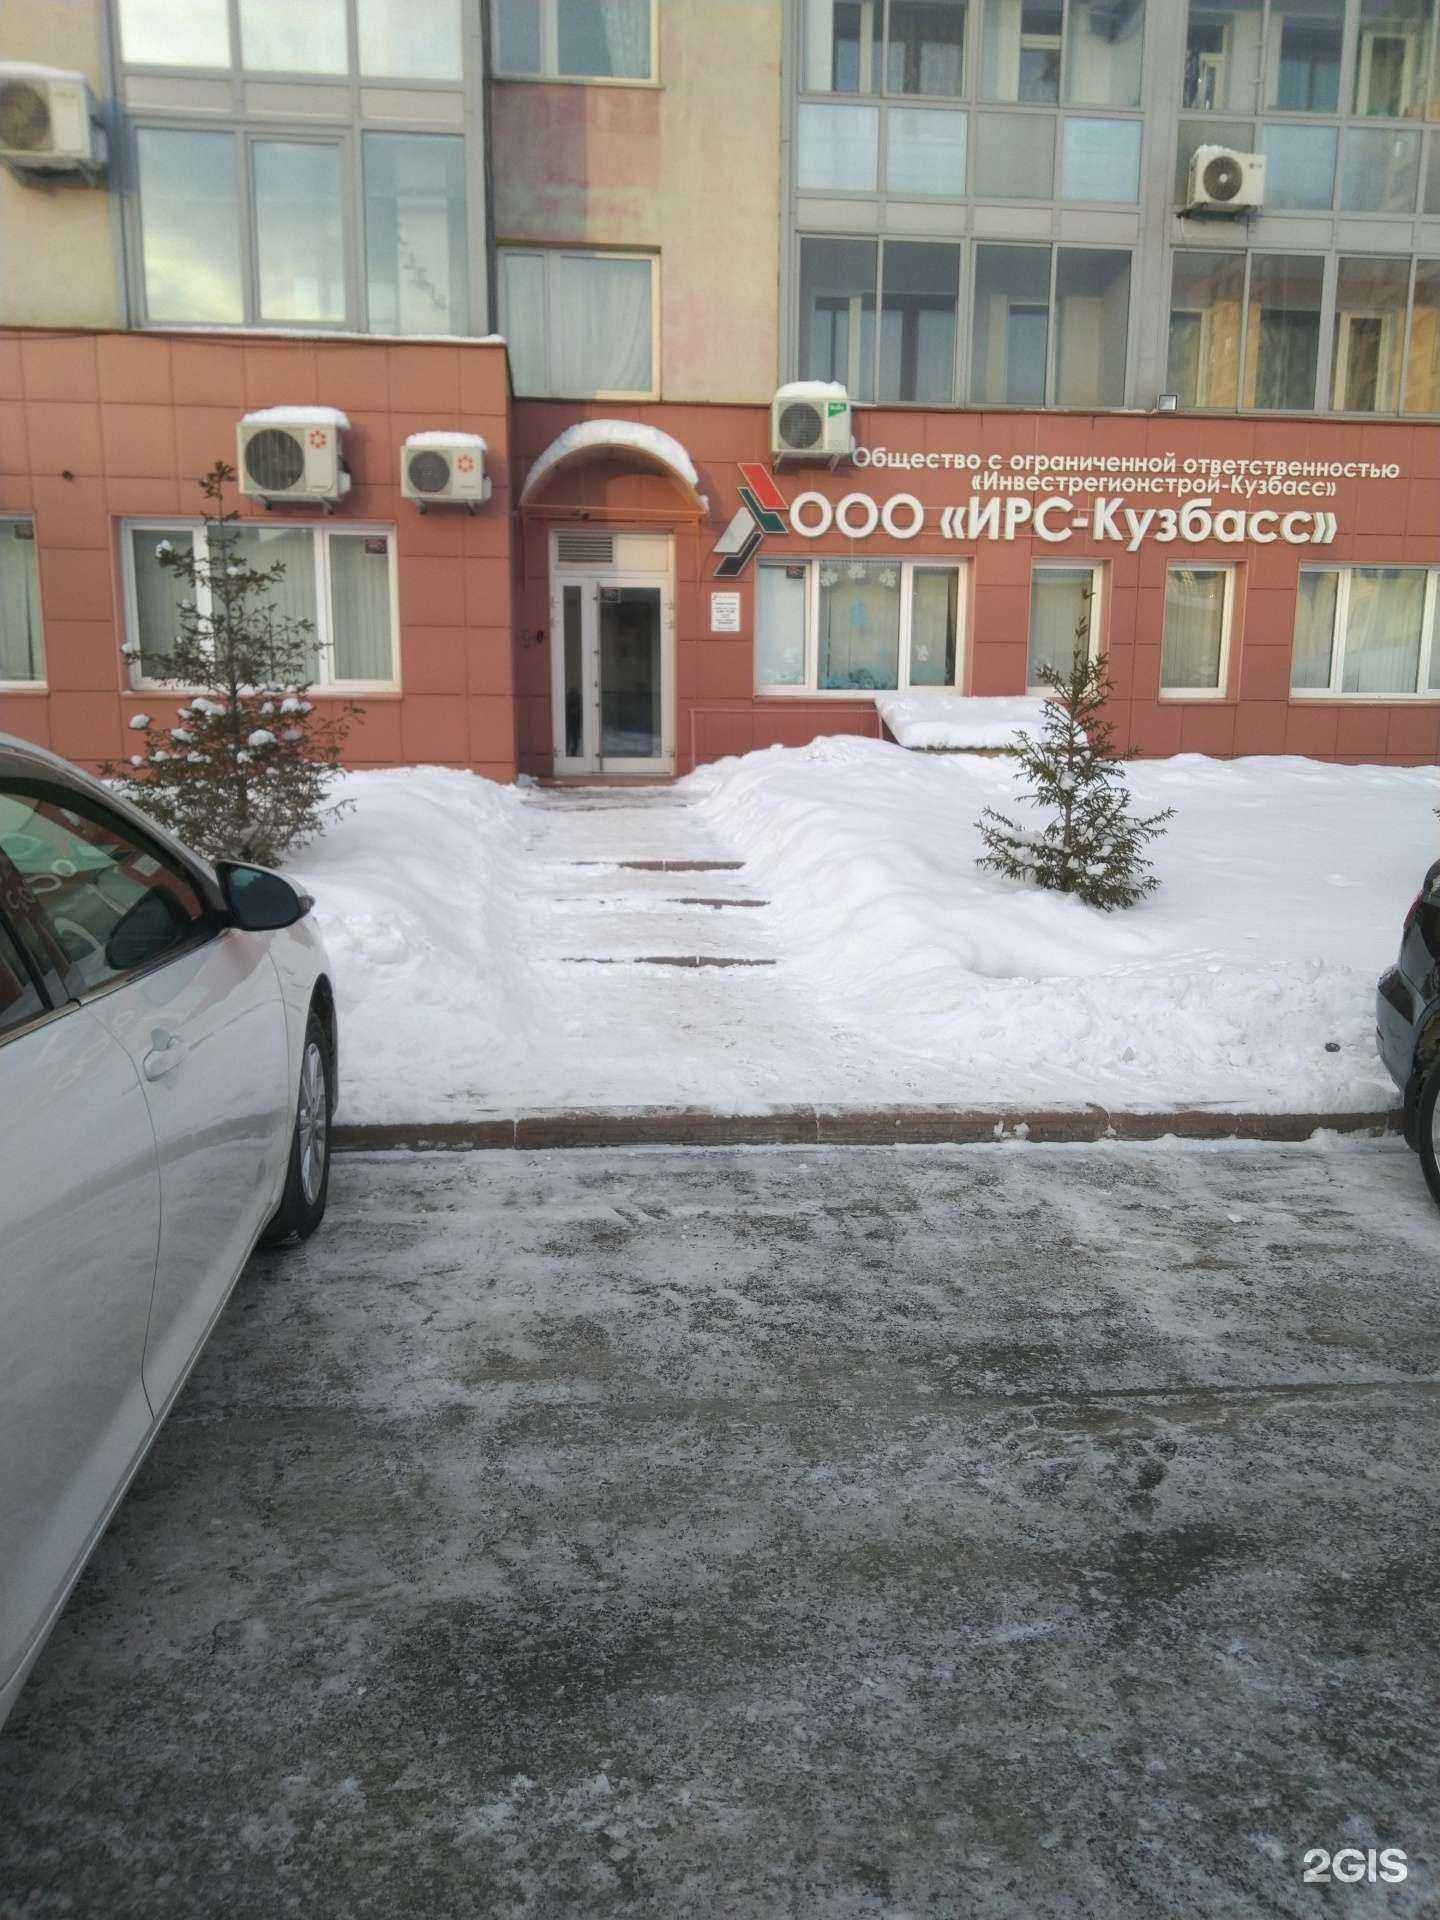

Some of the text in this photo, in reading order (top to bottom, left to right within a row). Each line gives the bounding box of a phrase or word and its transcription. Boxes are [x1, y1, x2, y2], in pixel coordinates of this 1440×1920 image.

[852, 447, 1400, 479] Общество с ограниченной ответственностью
[971, 471, 1336, 499] «Инвестрегионстрой-Кузбасс»
[789, 491, 1338, 552] ООО «ИРС-Кузбасс»
